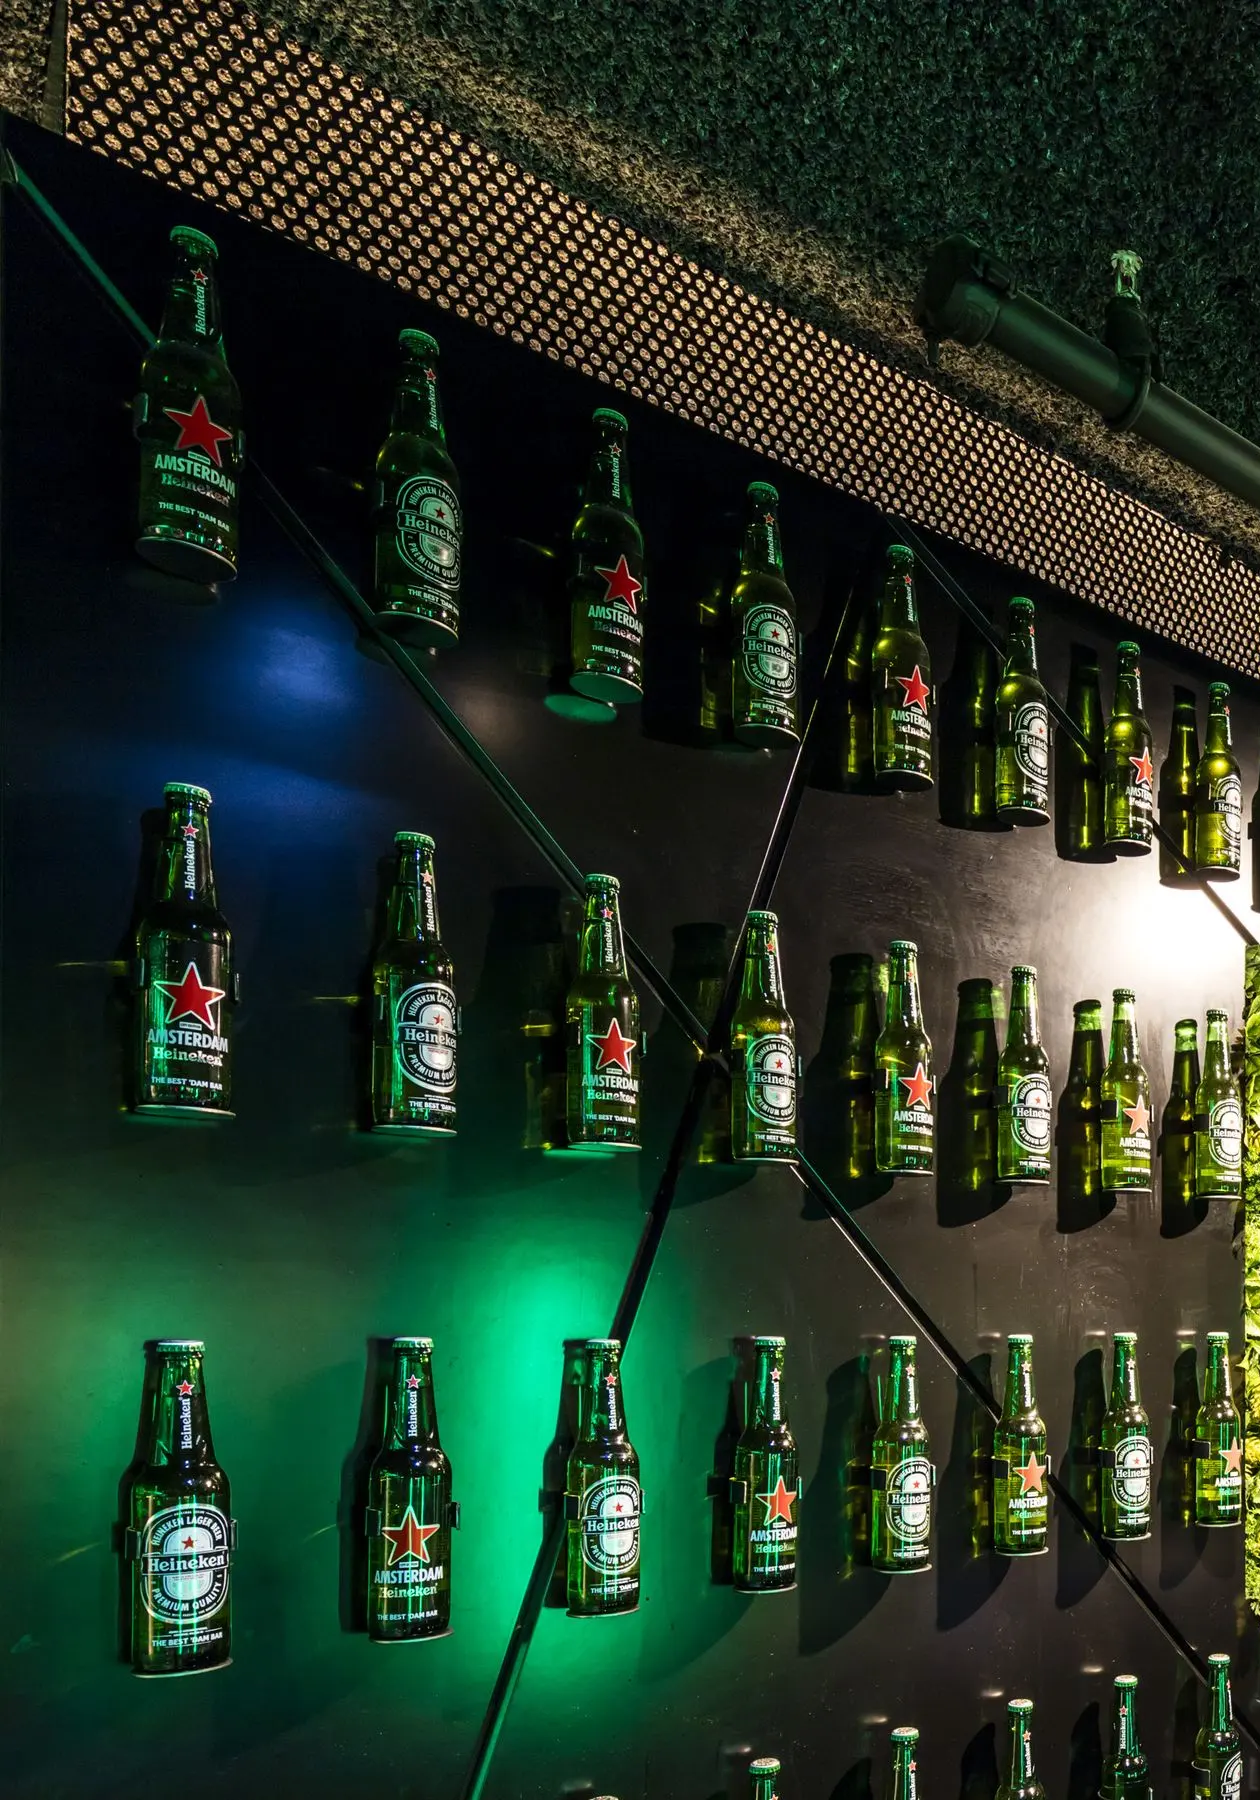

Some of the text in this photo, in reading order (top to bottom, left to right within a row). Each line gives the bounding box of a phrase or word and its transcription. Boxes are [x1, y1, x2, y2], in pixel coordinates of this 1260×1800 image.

[155, 454, 236, 498] AMSTERDAM
[158, 502, 174, 510] THE
[175, 504, 196, 515] BEST
[408, 588, 422, 598] THE
[184, 840, 195, 890] Heineken
[425, 886, 435, 931] Heineken
[605, 921, 613, 963] Heineken
[408, 994, 436, 1016] HEINEKEN
[148, 1028, 228, 1053] AMSTERDAM
[153, 1047, 222, 1066] Heineken
[408, 1054, 440, 1079] PREMIUM
[209, 1082, 222, 1090] BAR
[408, 1391, 417, 1437] Heineken
[608, 1388, 618, 1430] Heineken
[180, 1398, 192, 1449] Heineken
[152, 1516, 223, 1546] HEINEKEN LAGER BEER
[148, 1554, 225, 1572] Heineken
[375, 1566, 443, 1583] AMSTERDAM
[152, 1583, 222, 1611] PREMIUM QUALITY
[379, 1584, 437, 1598] Heineken
[152, 1639, 166, 1647] THE
[168, 1637, 188, 1646] BEST
[210, 1632, 222, 1640] BAR
